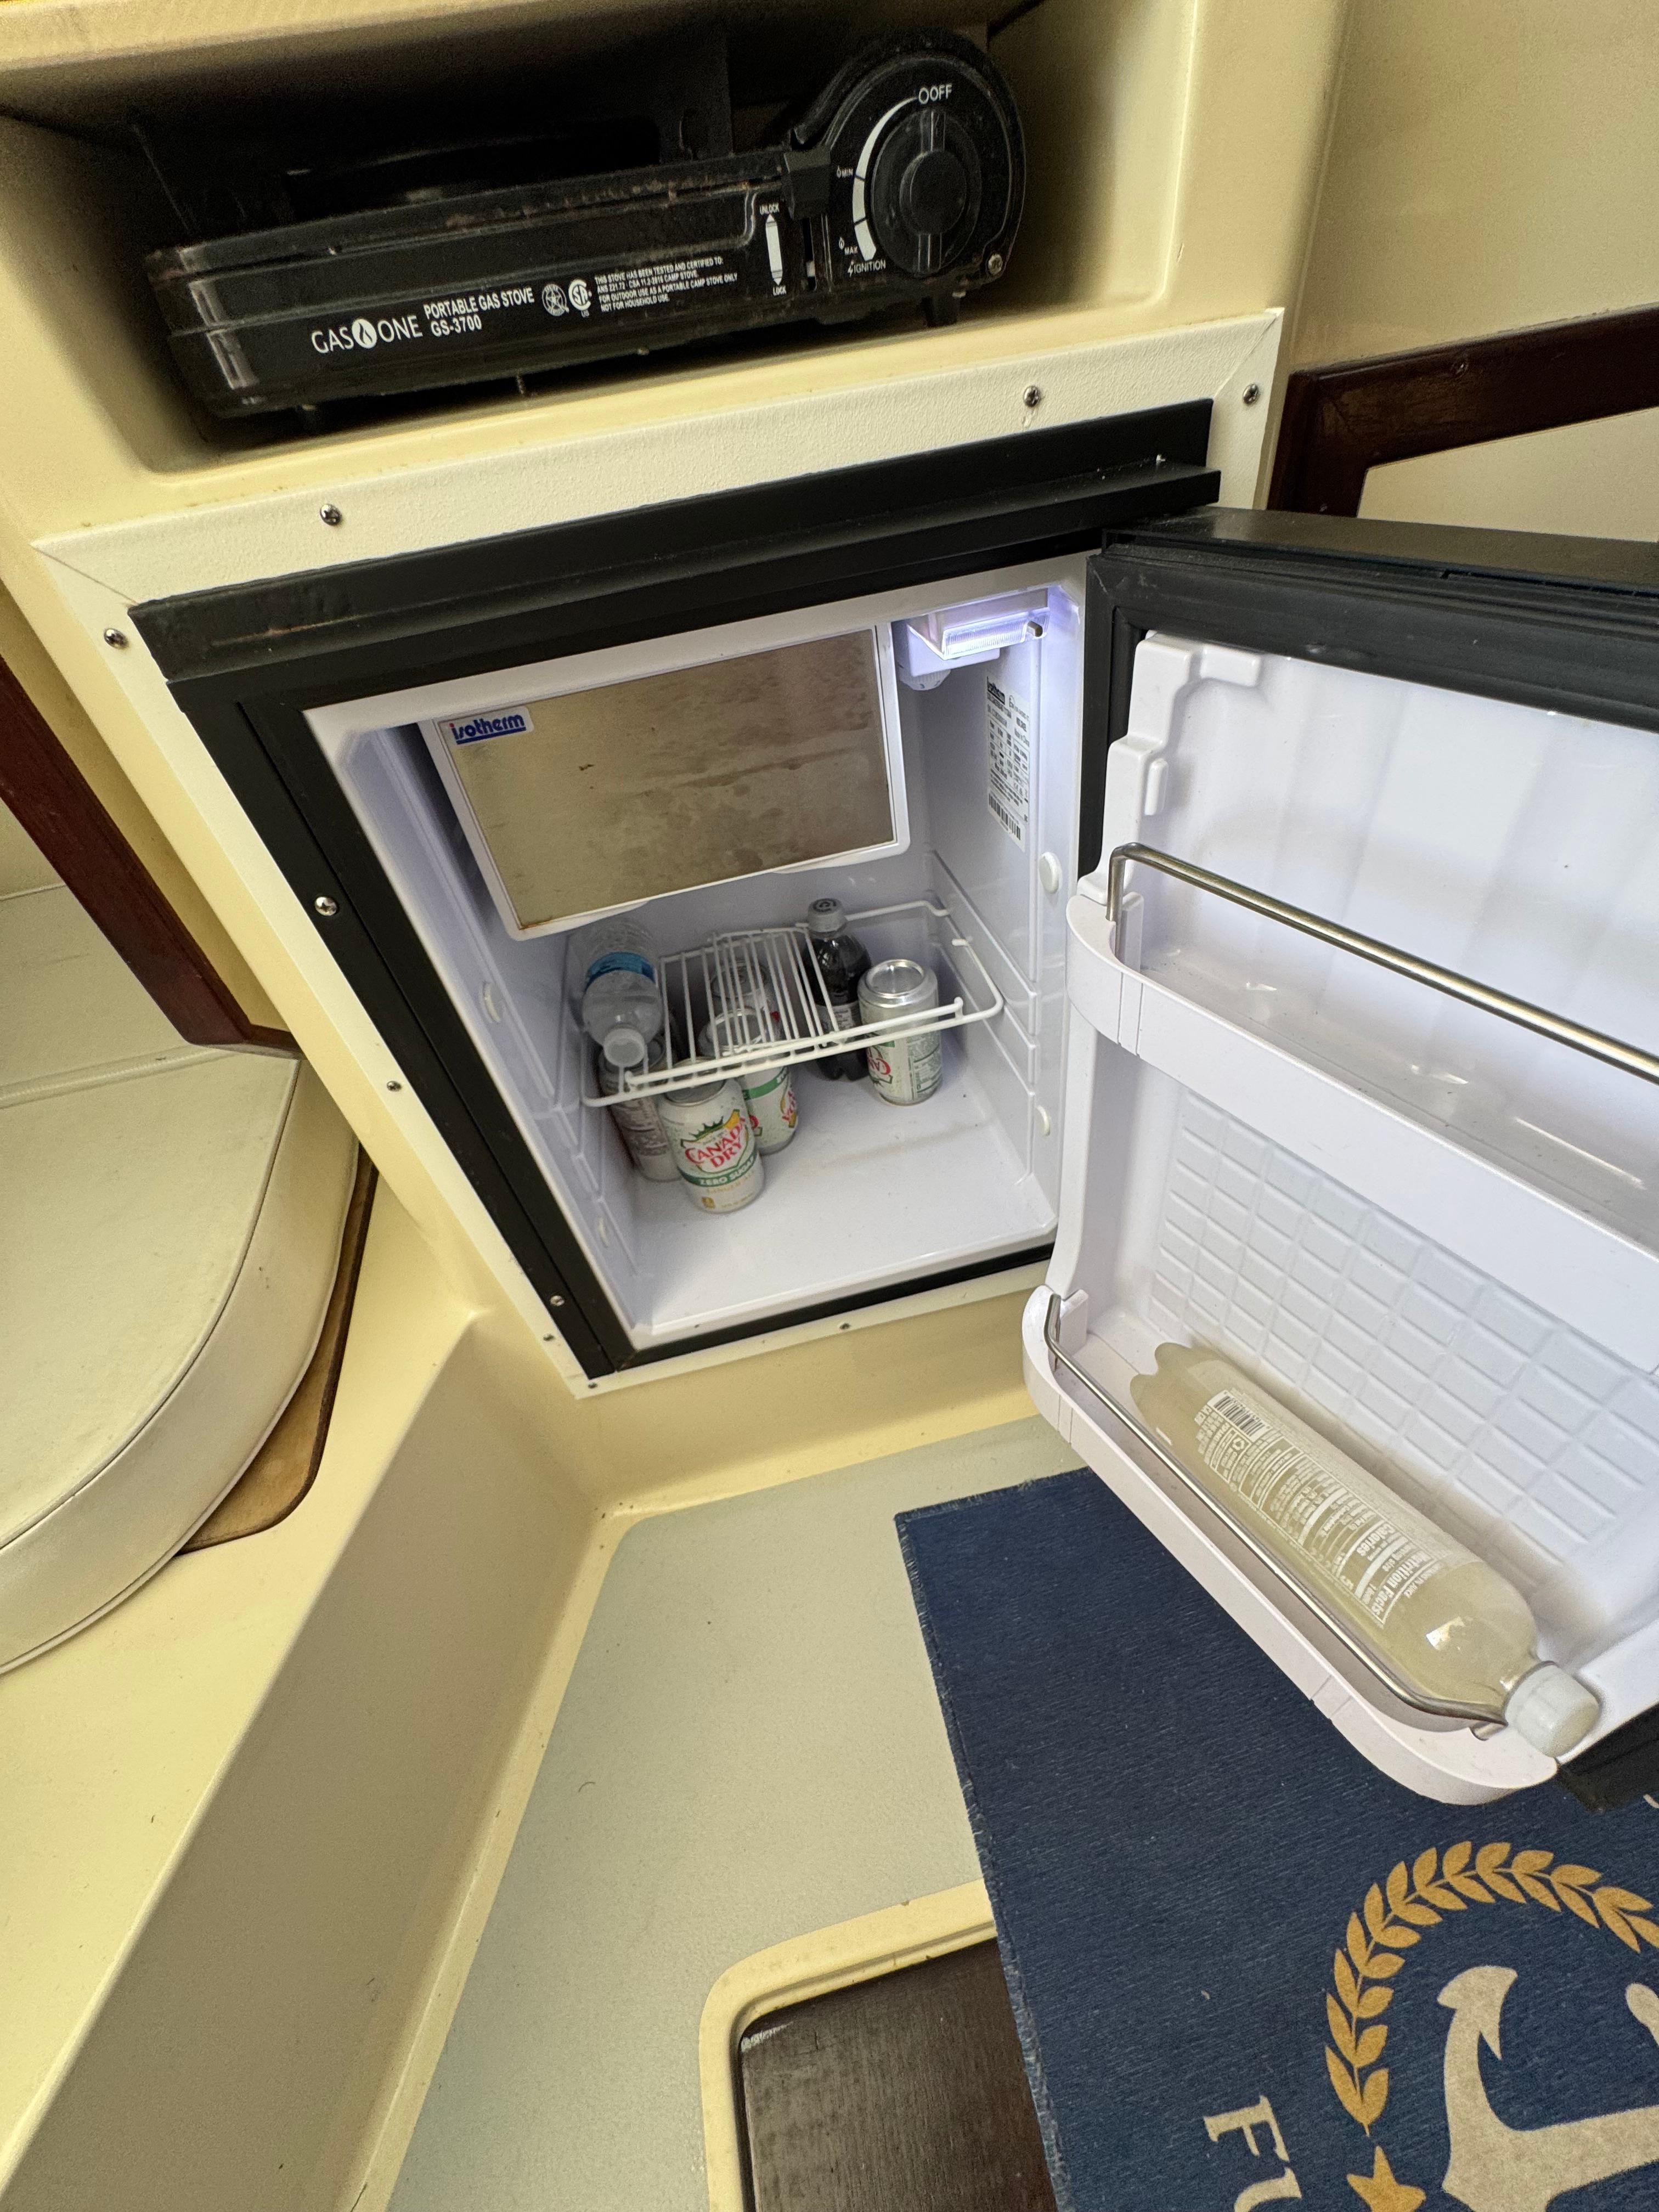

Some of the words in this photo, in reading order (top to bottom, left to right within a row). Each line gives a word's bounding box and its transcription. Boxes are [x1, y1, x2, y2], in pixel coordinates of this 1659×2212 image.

[759, 202, 780, 215] UNLOCK
[844, 246, 858, 256] MAX
[594, 275, 607, 285] THIS
[607, 272, 625, 283] STOVE
[626, 269, 638, 280] HAS
[638, 267, 653, 278] BEEN
[653, 264, 674, 275] TESTED
[674, 262, 686, 272] AND
[686, 257, 714, 269] CERTIFIED
[854, 259, 886, 274] IGNITION
[599, 294, 611, 304] FOR
[611, 289, 637, 302] OUTDOOR
[637, 287, 650, 297] USE
[650, 285, 658, 295] AS
[662, 280, 690, 293] PORTABLE
[690, 278, 706, 289] CAMP
[706, 275, 724, 286] STOVE
[724, 272, 737, 283] ONLY
[628, 279, 641, 289] CSA
[664, 273, 679, 283] CAMP
[772, 286, 786, 297] LOCK
[424, 297, 478, 320] PORTABLE
[479, 294, 500, 312] GAS
[502, 287, 534, 307] STOVE
[601, 302, 612, 312] NOT
[612, 301, 625, 311] FOR
[625, 296, 657, 308] HOUSEHOLD
[431, 315, 483, 337] GS-3700
[710, 1142, 742, 1168] DRY
[699, 1176, 728, 1186] ZERO
[1356, 1522, 1396, 1557] Calories
[1386, 1549, 1432, 1589] Nutrition
[1370, 1584, 1395, 1615] Facts
